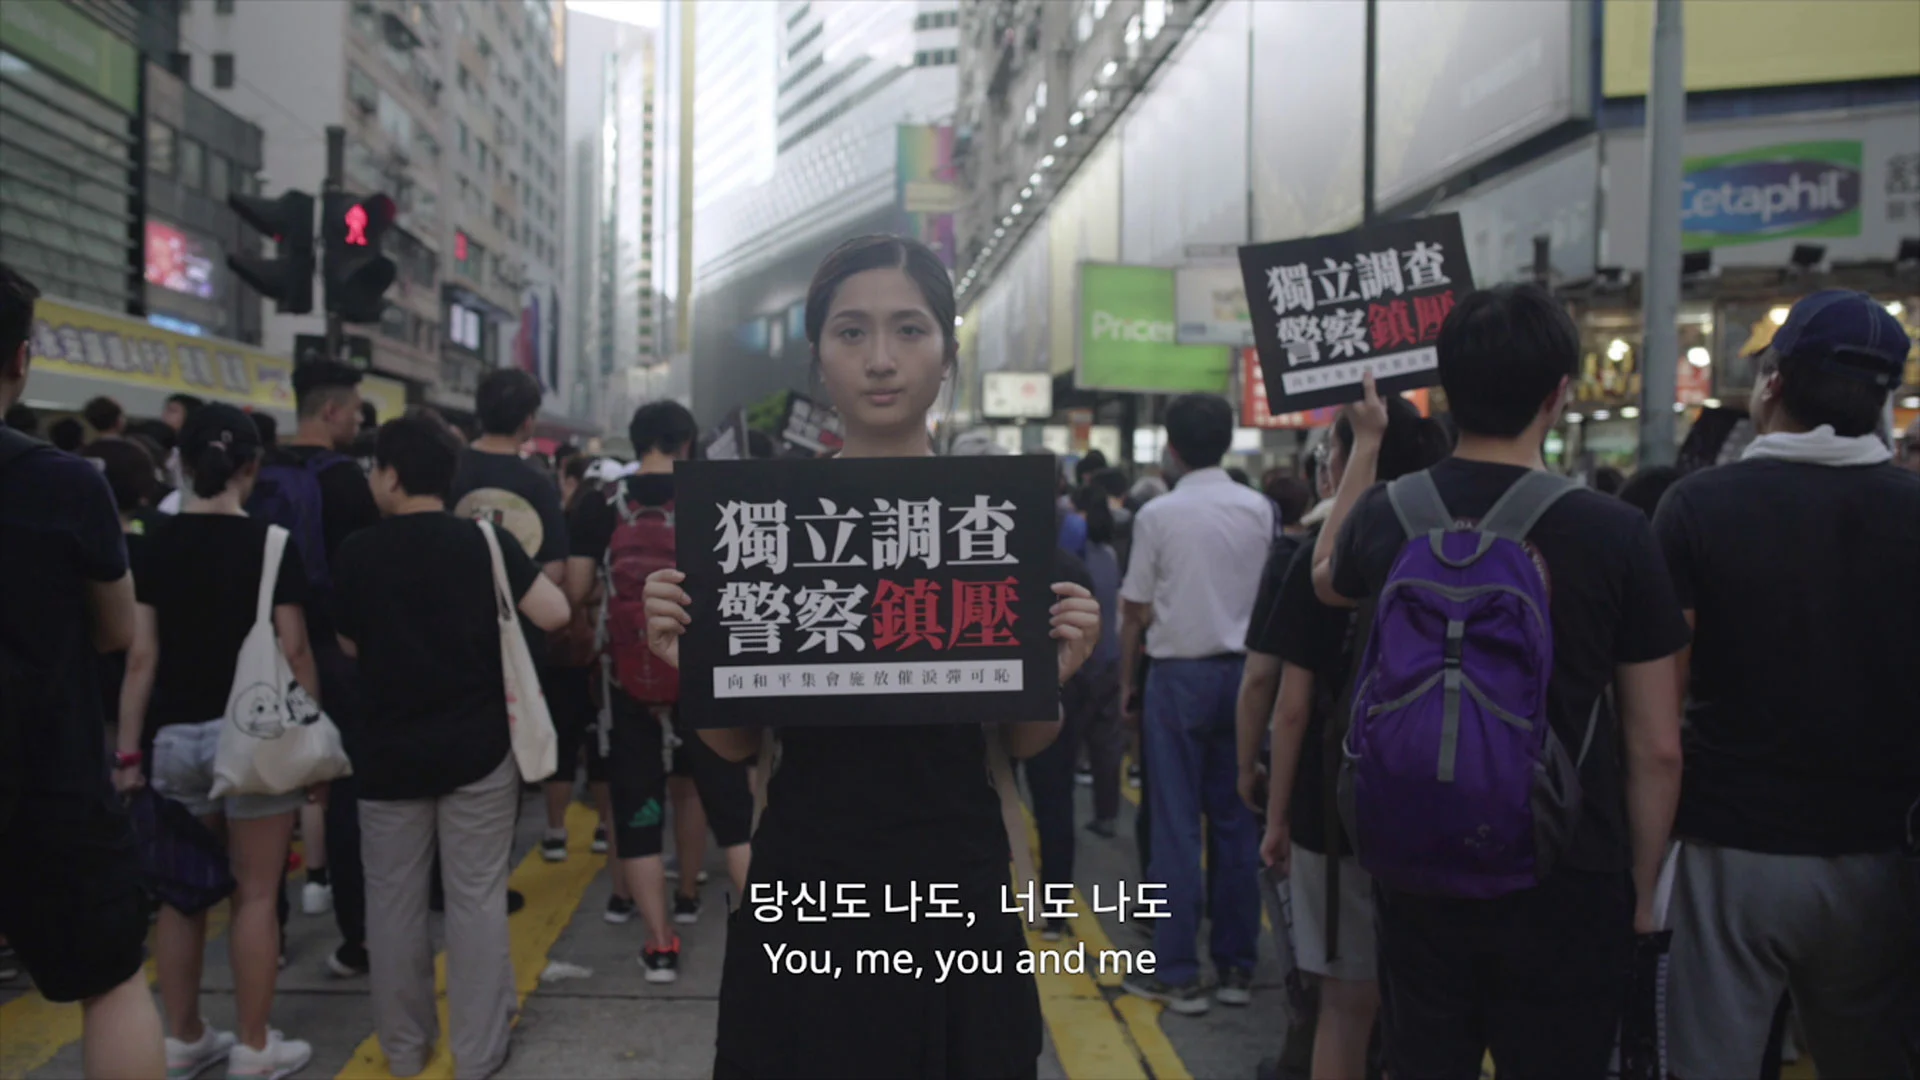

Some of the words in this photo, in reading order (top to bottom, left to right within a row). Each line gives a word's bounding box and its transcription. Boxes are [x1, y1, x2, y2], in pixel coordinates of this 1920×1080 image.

[1265, 241, 1451, 315] 獨立調查
[713, 494, 1019, 575] 獨立調查
[717, 575, 1020, 656] 警察鎮壓
